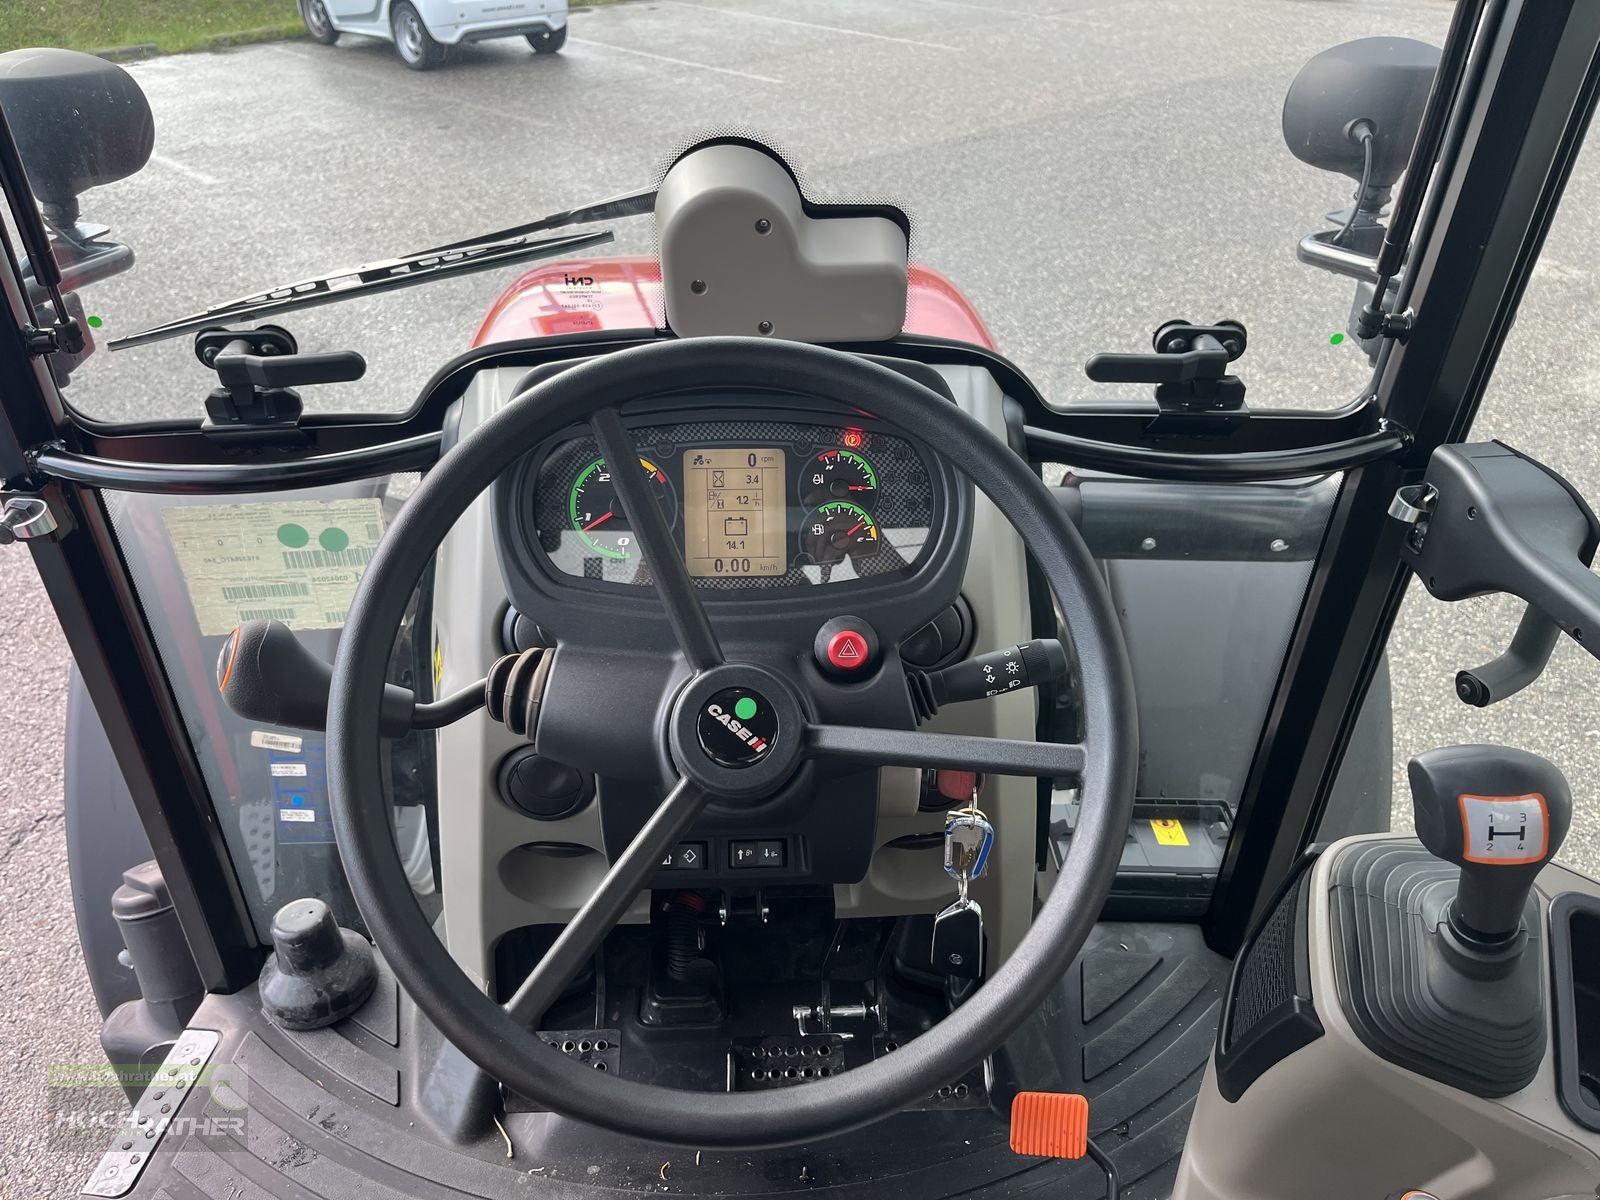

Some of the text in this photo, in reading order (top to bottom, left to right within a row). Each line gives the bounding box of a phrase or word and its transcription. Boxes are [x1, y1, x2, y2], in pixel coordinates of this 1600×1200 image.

[747, 453, 757, 467] 0
[598, 473, 611, 482] 2
[746, 475, 759, 484] 3.4
[585, 513, 592, 521] 1
[617, 537, 630, 546] 0
[726, 540, 745, 550] 14.1
[714, 559, 751, 573] 0.00
[708, 704, 752, 741] CASE
[1488, 813, 1527, 823] 1 3
[1486, 843, 1493, 851] 2
